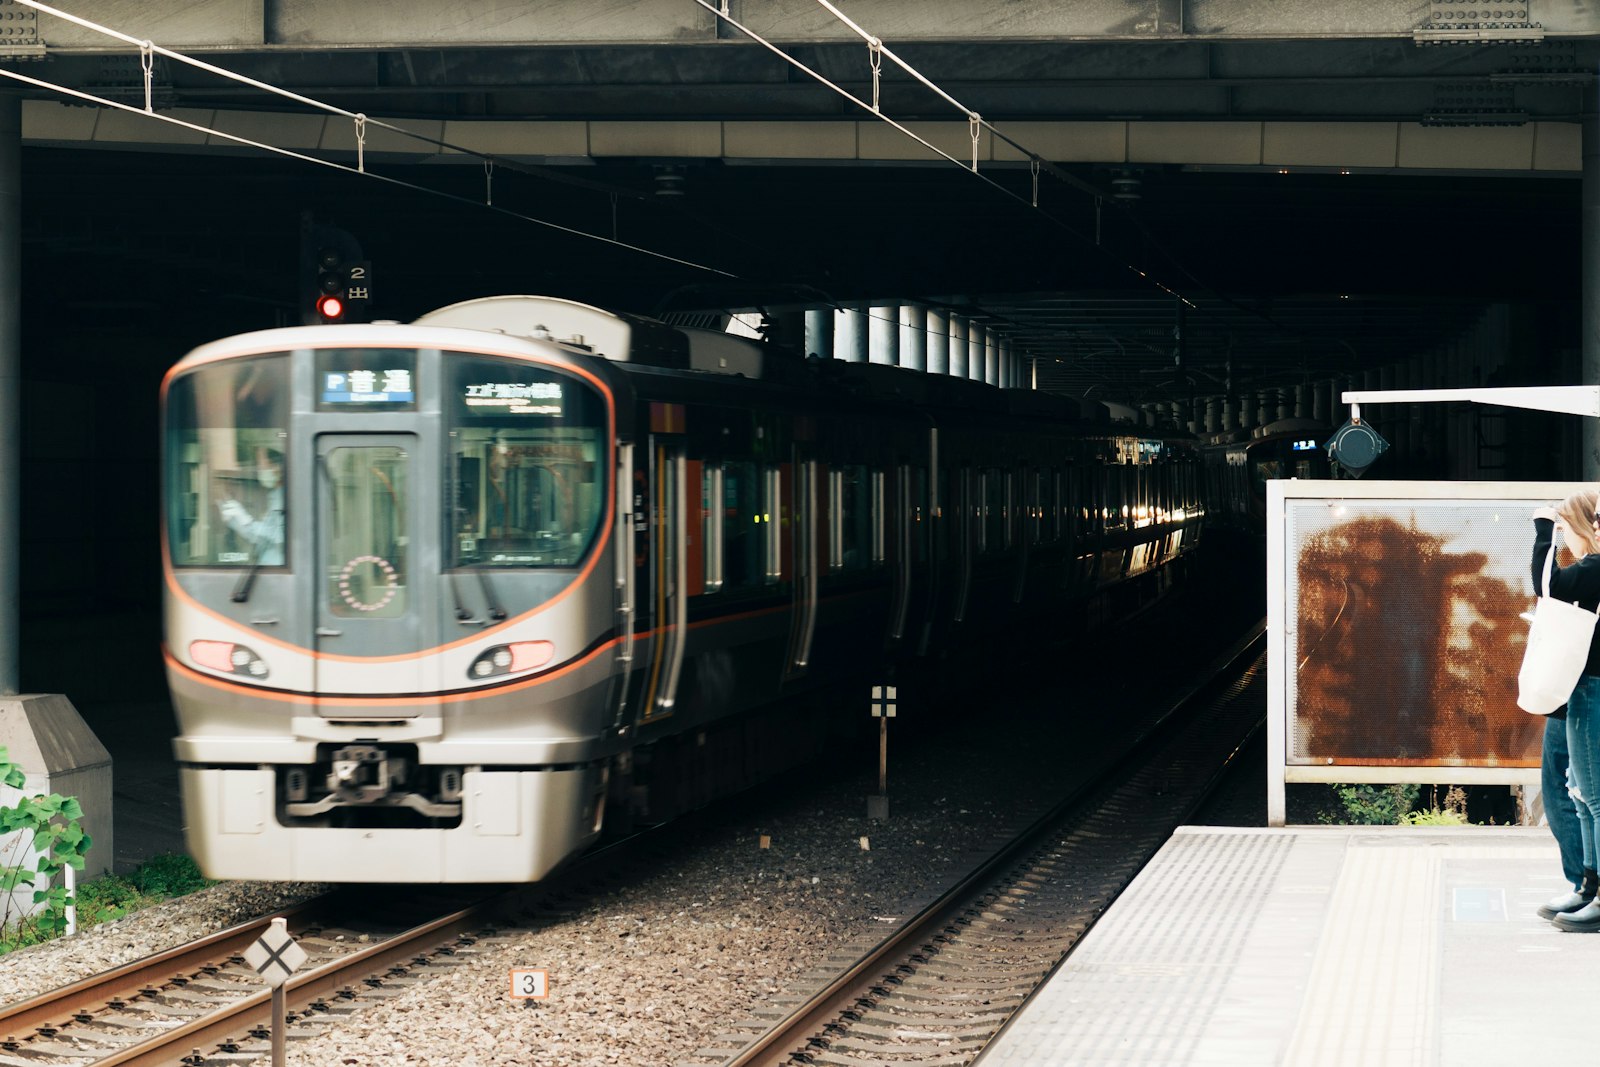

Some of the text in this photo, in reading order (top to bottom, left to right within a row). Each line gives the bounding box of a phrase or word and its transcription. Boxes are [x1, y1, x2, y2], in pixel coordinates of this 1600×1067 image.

[351, 267, 365, 279] 2
[349, 287, 369, 299] 出
[523, 975, 535, 994] 3
